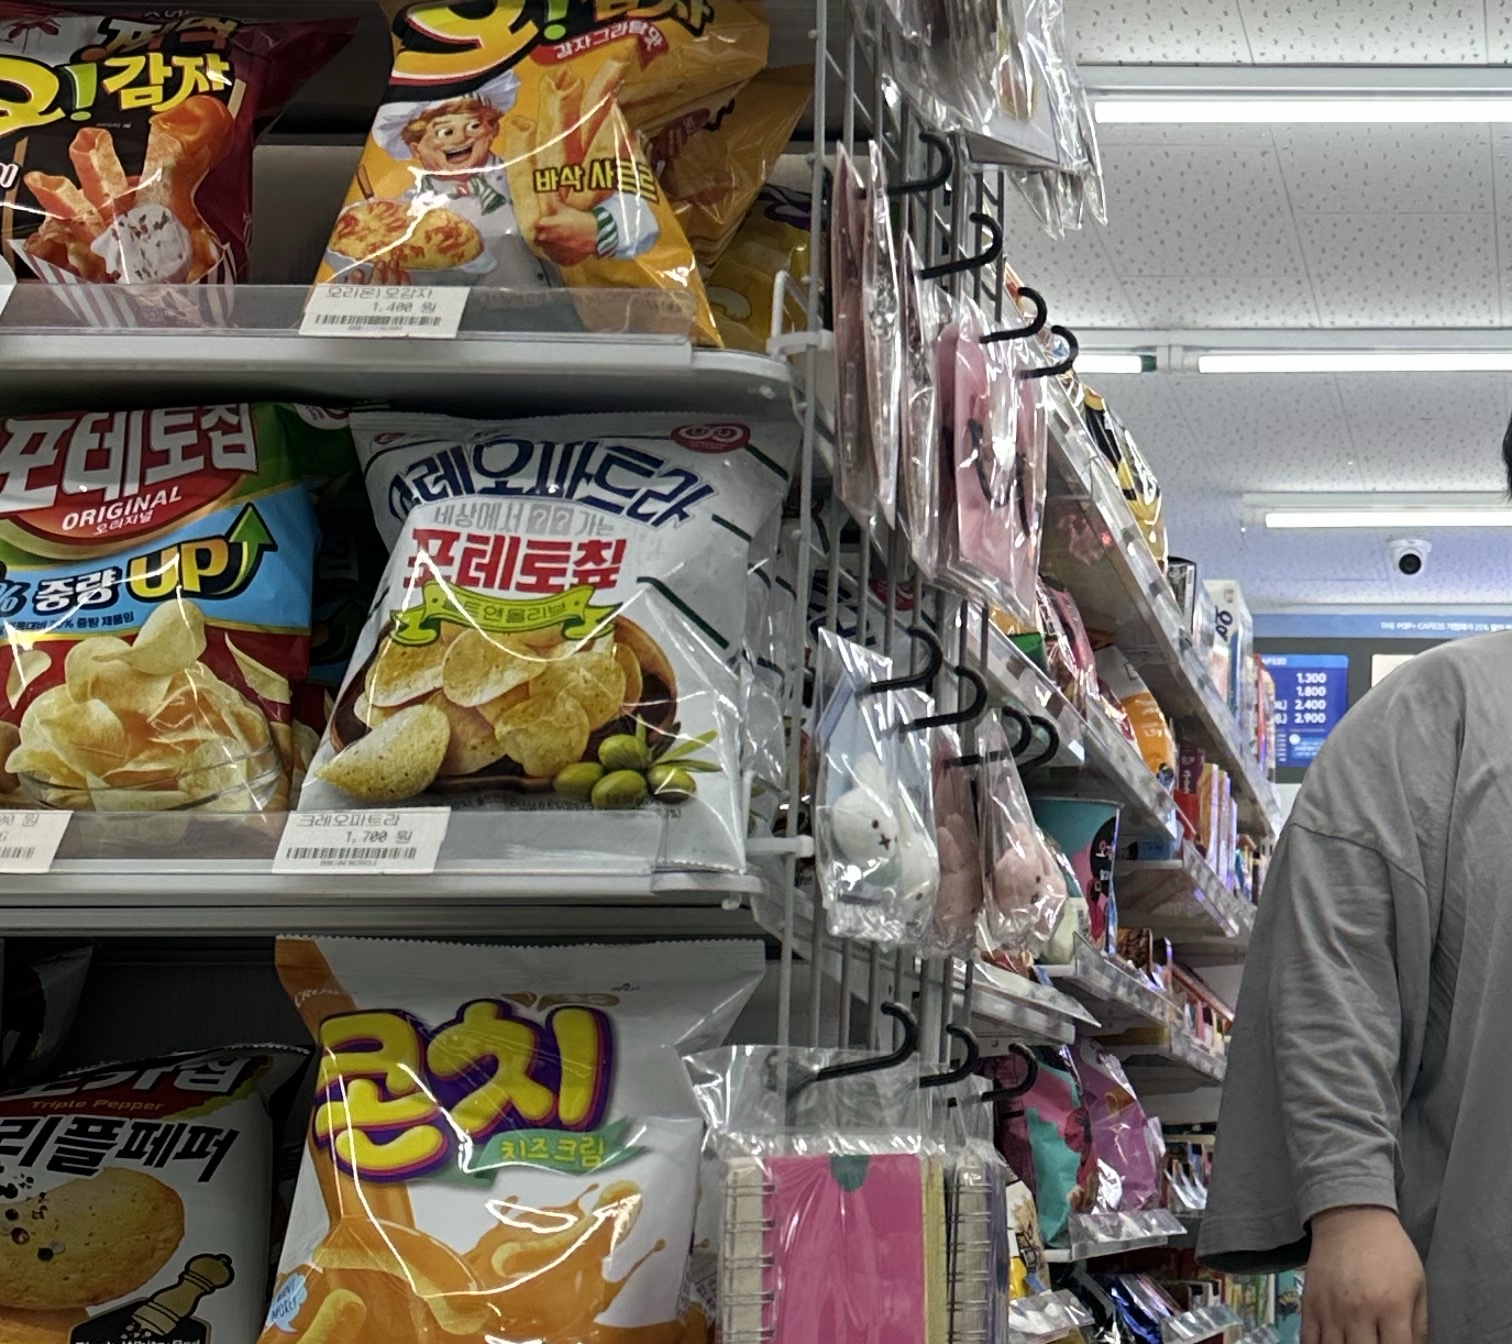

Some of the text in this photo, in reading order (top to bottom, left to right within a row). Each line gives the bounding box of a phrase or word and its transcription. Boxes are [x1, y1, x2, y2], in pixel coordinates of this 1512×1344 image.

[532, 166, 586, 194] 바삭
[61, 485, 182, 532] ORIGINAL
[36, 537, 229, 614] 중량 UP
[30, 1098, 165, 1112] Triple Pepper
[314, 1000, 601, 1176] 콘치
[501, 1135, 605, 1168] 치즈크림
